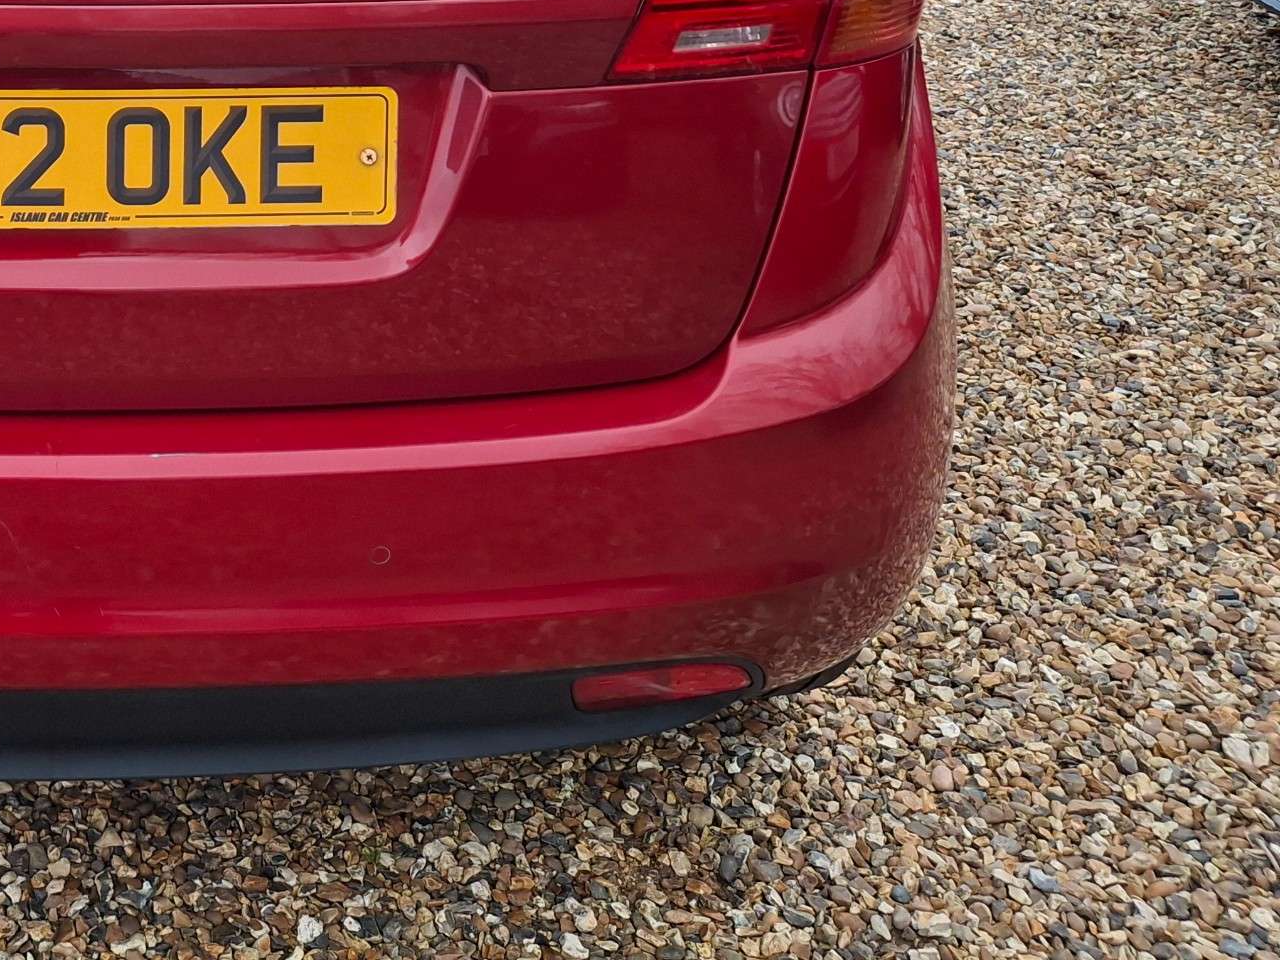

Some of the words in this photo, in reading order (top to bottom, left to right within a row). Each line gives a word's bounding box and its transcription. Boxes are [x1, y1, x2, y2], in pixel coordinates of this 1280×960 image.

[105, 104, 325, 207] OKE
[10, 211, 46, 223] ISLAND
[48, 211, 70, 223] CAR
[70, 211, 109, 222] CENTRE
